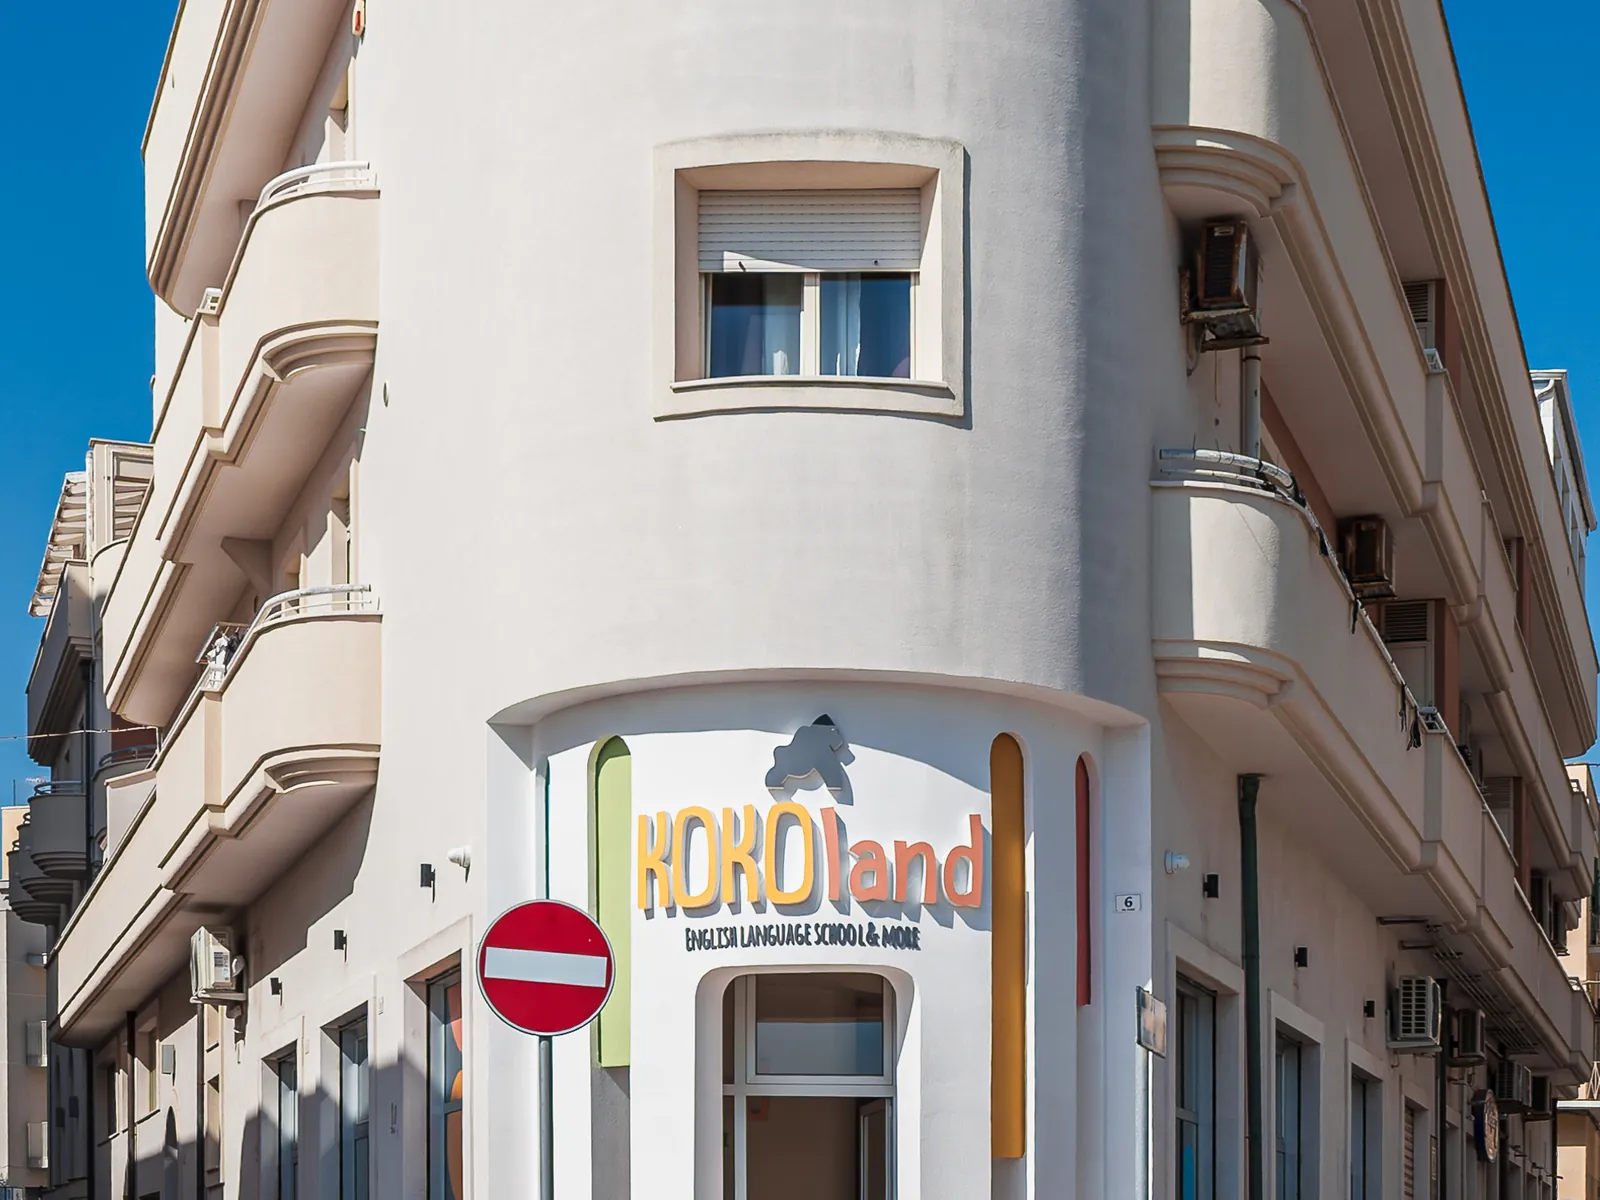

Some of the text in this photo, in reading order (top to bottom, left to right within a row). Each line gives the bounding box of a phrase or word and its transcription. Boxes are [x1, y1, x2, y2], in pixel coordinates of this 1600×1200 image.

[637, 802, 984, 909] KOKOland
[1124, 896, 1133, 908] 6
[685, 927, 738, 951] ENGLISH
[740, 923, 812, 948] LANGUAGE
[814, 923, 866, 947] SCHOOL
[882, 924, 921, 951] MORE
